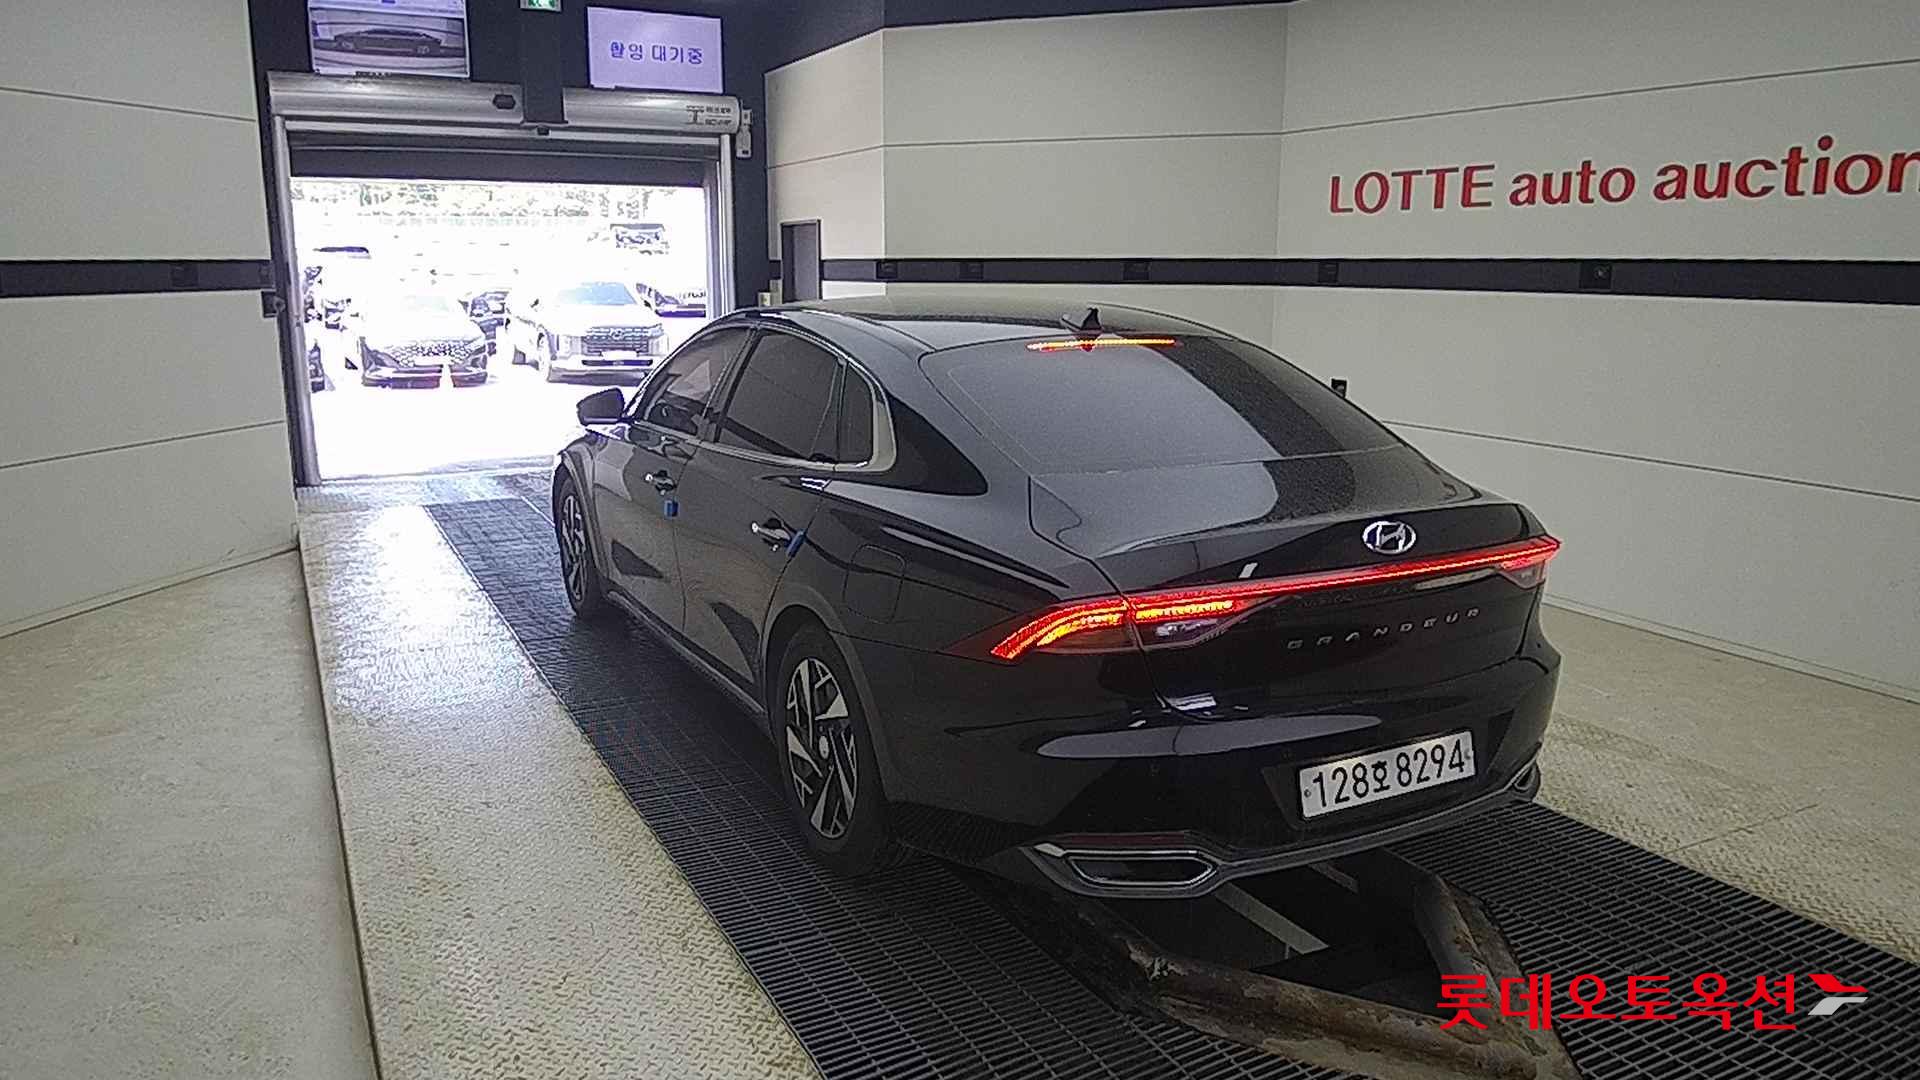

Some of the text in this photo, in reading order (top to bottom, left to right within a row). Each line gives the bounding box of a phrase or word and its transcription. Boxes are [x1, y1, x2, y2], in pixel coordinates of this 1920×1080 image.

[1330, 135, 1920, 214] LOTTE auto auction
[1287, 608, 1480, 649] GRANDEUR
